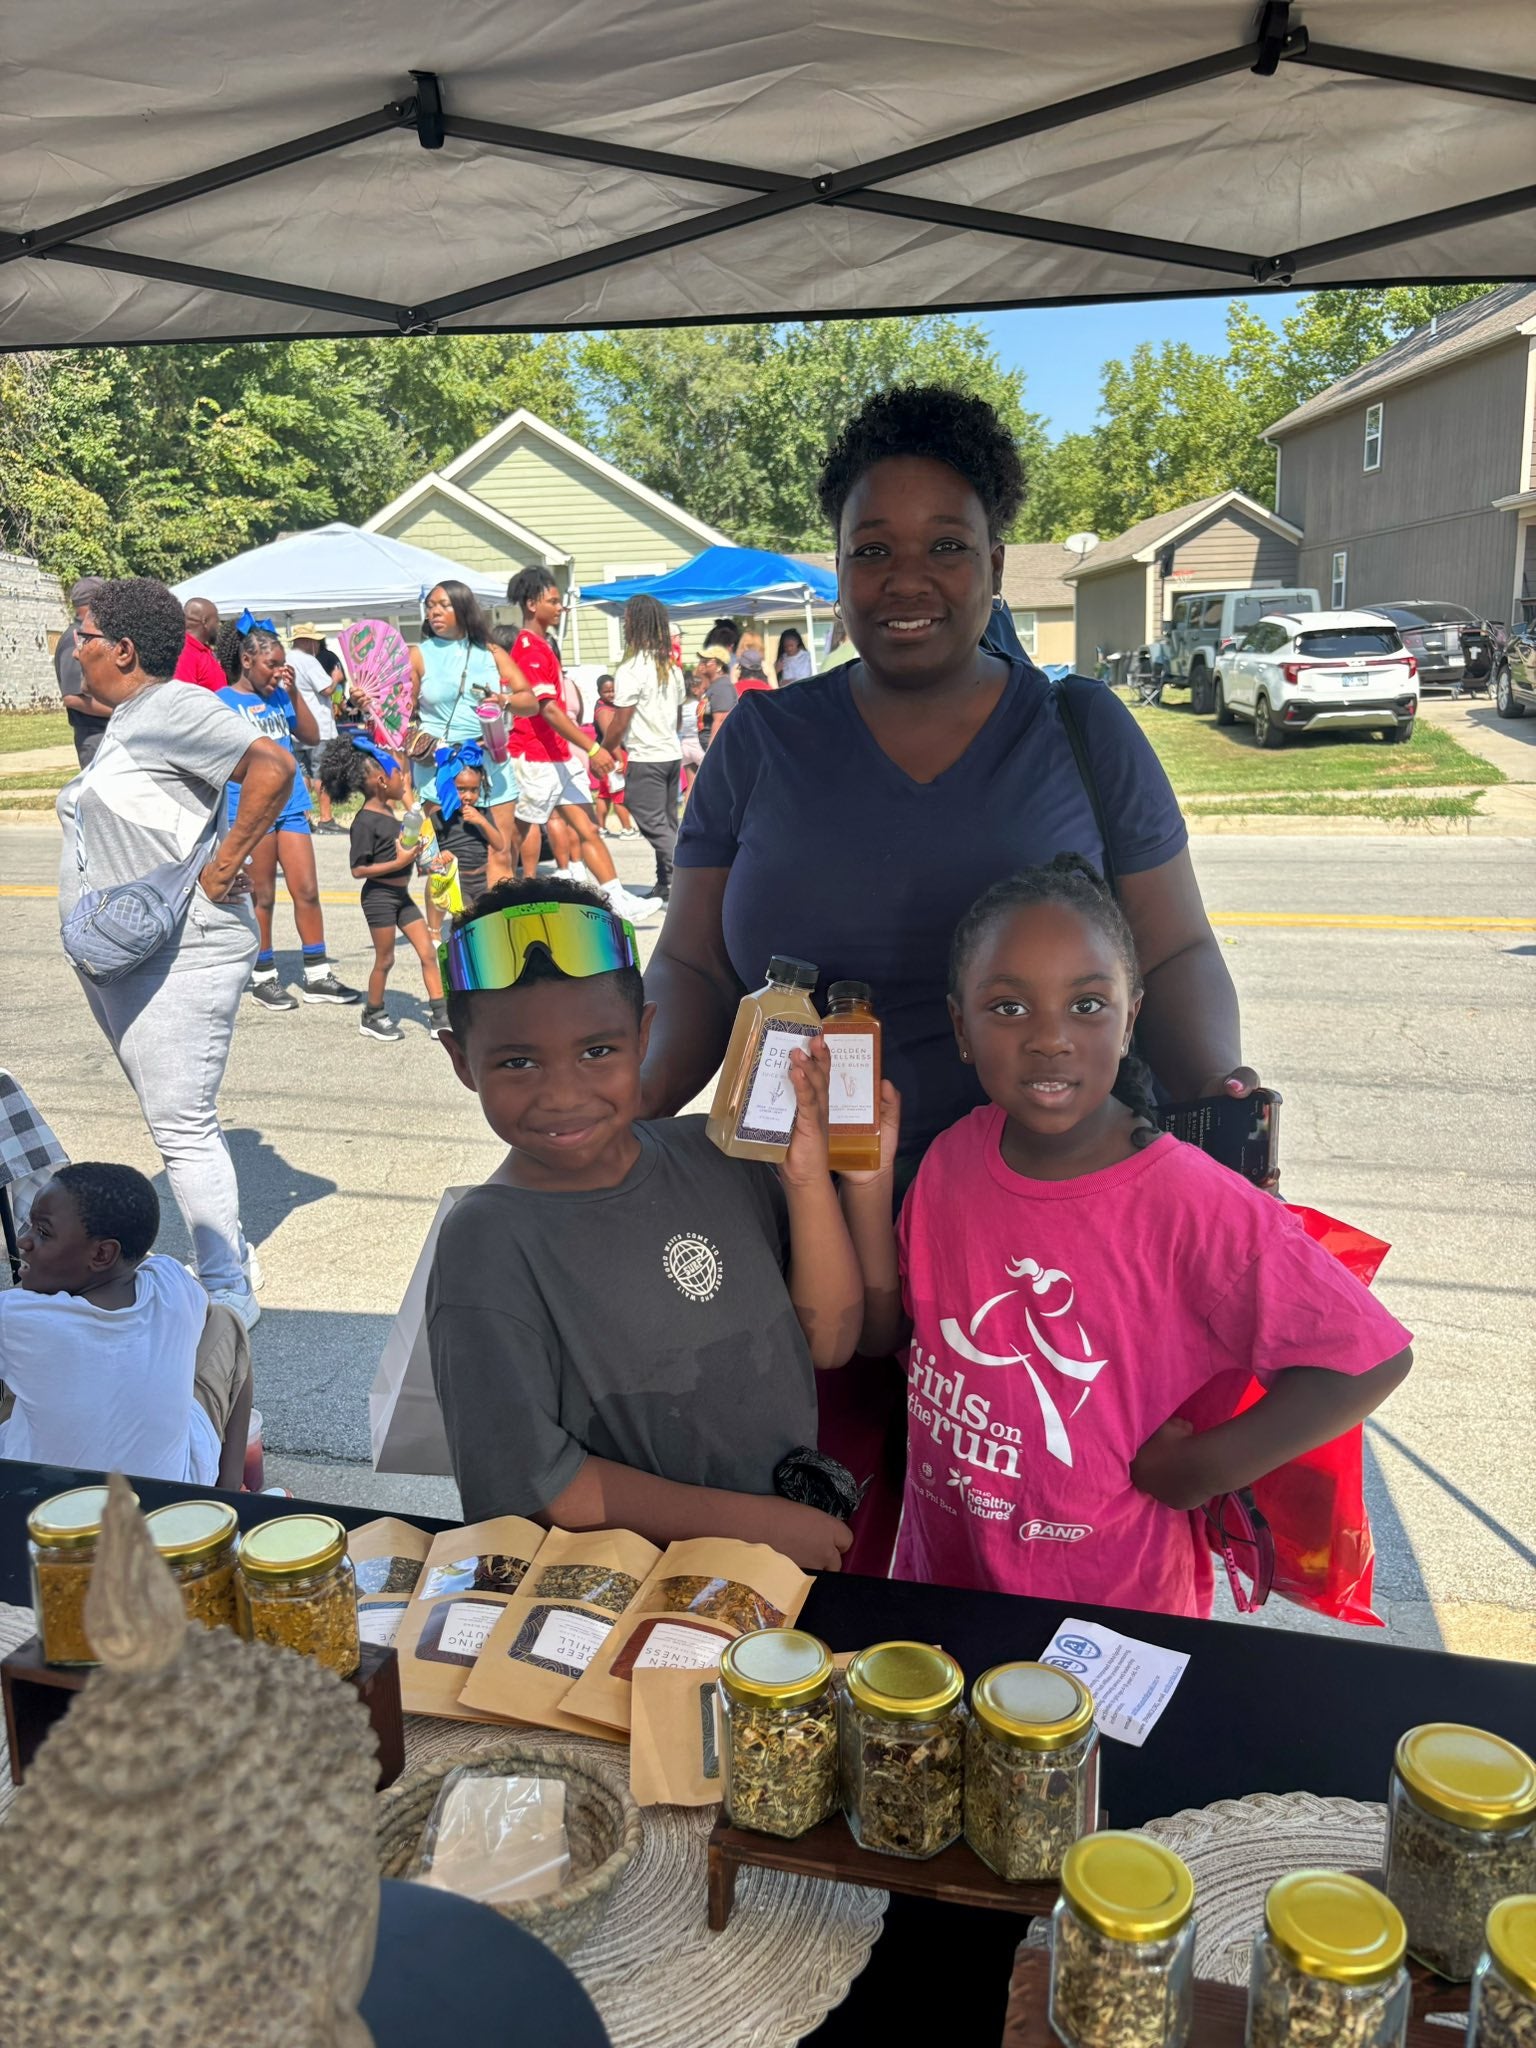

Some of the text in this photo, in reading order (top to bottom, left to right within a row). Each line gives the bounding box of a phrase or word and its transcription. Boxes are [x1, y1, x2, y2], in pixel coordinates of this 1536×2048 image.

[769, 1047, 792, 1059] DEE
[764, 1058, 792, 1071] CHIL
[662, 1232, 724, 1303] GOOD WAVES COME TO THOSE WHO WAIT
[683, 1256, 704, 1276] SURF
[908, 1338, 1022, 1444] Girls on
[908, 1392, 1022, 1479] the run
[966, 1500, 1010, 1520] futures
[967, 1490, 1016, 1514] healthy
[1028, 1523, 1086, 1541] BAND
[448, 1636, 483, 1649] PING
[458, 1630, 484, 1639] UTY
[645, 1647, 706, 1668] ELLNESS
